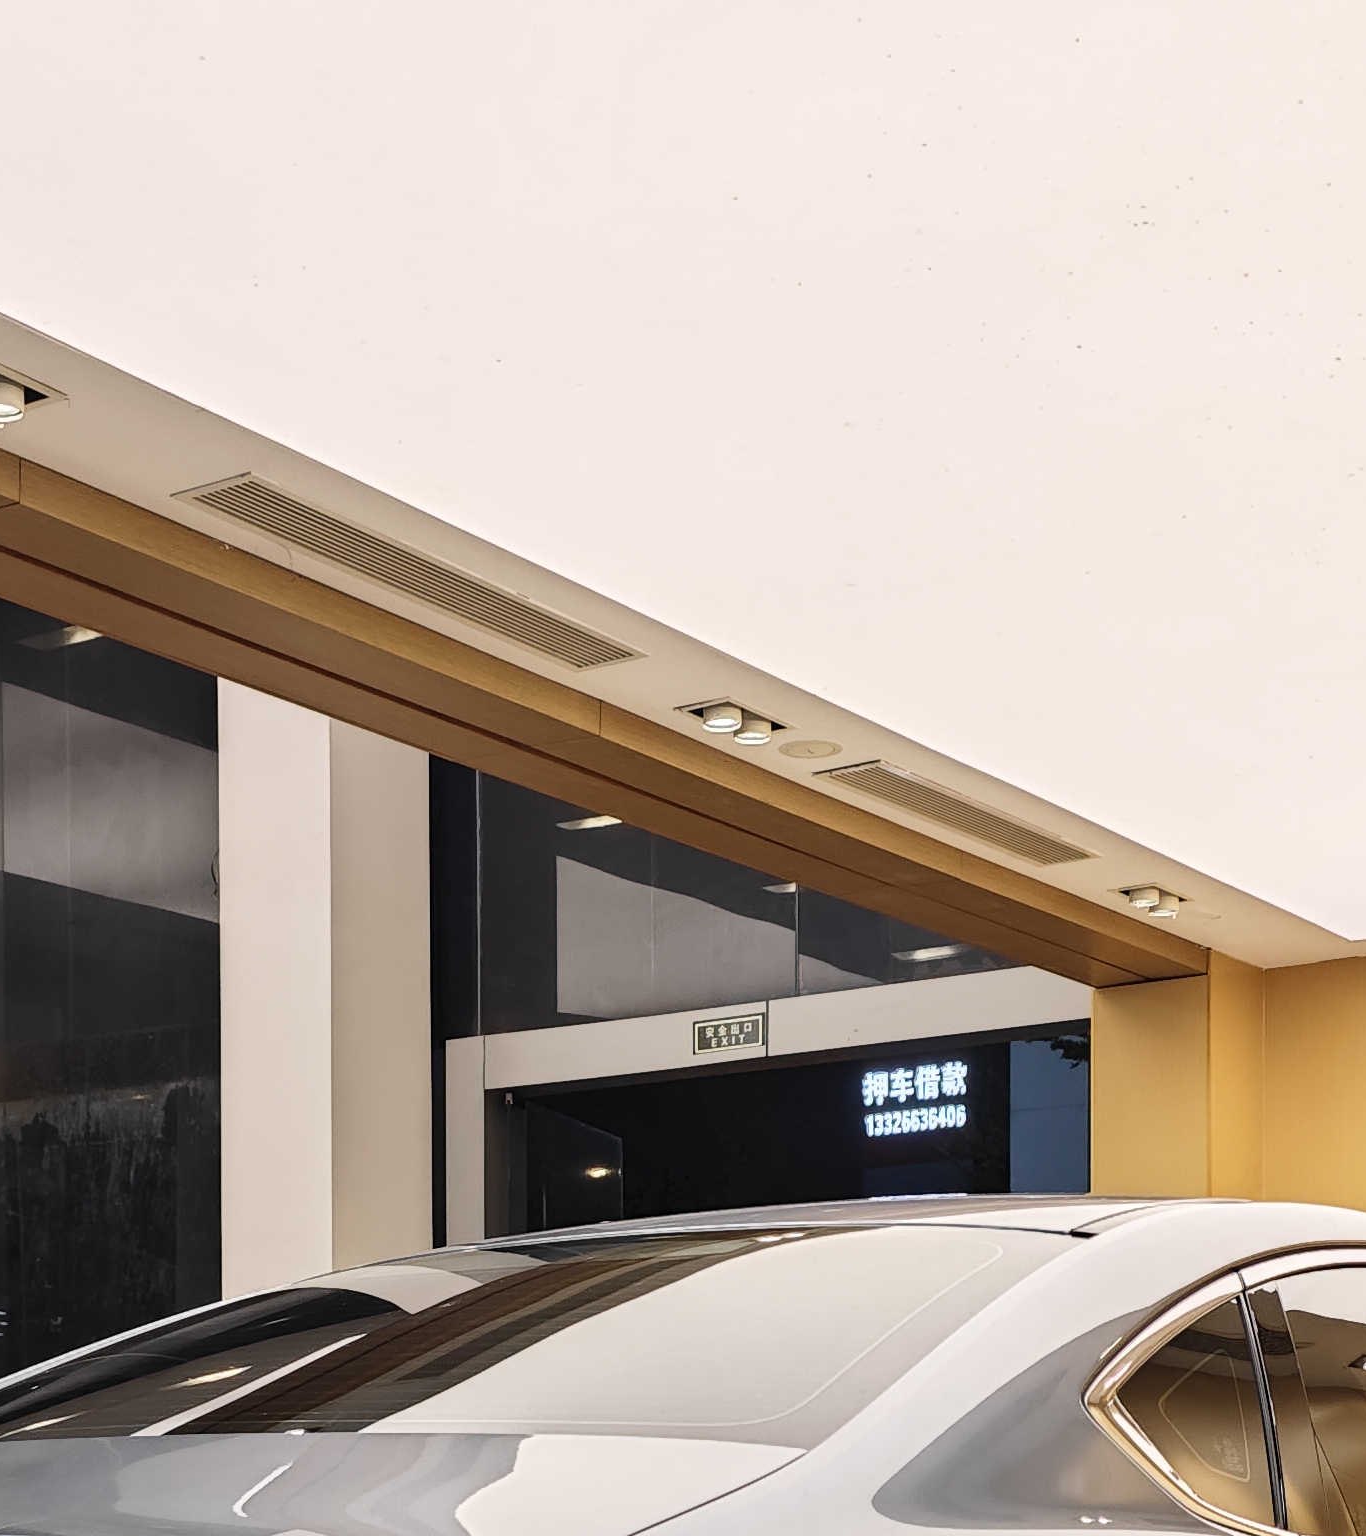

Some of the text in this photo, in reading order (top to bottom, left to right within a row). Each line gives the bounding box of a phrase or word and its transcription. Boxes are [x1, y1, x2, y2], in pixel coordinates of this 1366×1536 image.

[705, 1022, 752, 1038] 安全出口
[711, 1034, 745, 1047] EXIT
[862, 1061, 968, 1106] 押车借款
